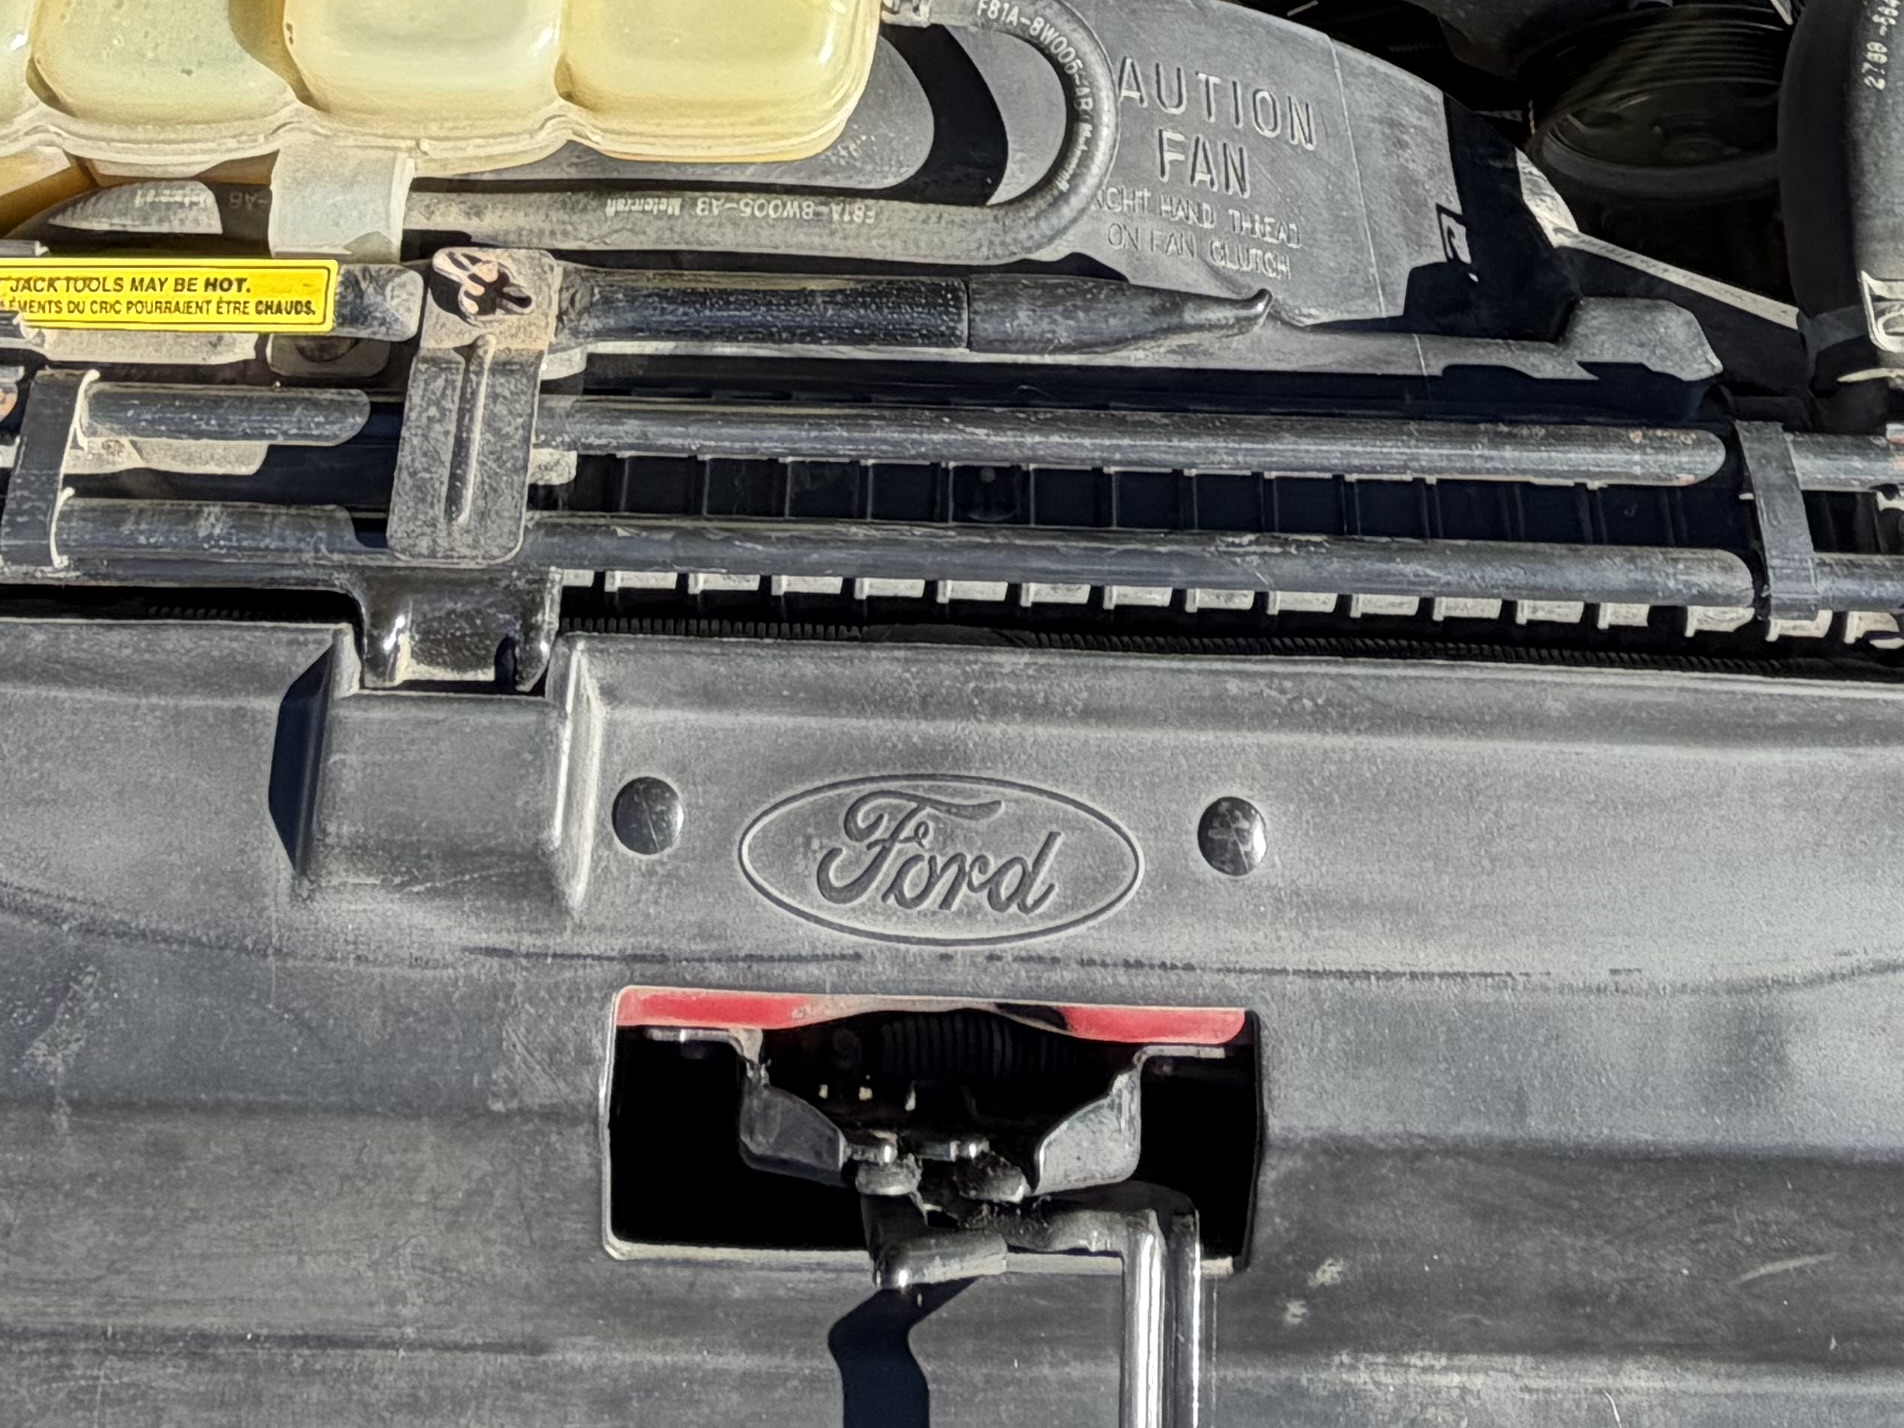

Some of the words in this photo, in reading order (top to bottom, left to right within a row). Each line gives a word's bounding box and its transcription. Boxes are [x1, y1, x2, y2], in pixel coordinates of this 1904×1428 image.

[1118, 55, 1317, 150] AUTION
[1157, 127, 1251, 199] FAN
[604, 197, 684, 217] Motorcraft
[695, 196, 878, 222] F81A-8W005-AB
[1159, 195, 1216, 230] HAND
[1228, 207, 1303, 249] THREAD
[1106, 222, 1140, 251] ON
[1151, 229, 1195, 259] FAN
[1209, 238, 1292, 280] CLUTCH
[9, 277, 58, 293] JACK
[64, 277, 124, 293] TOOLS
[129, 277, 169, 293] MAY
[173, 277, 199, 293] BE
[203, 277, 252, 293] HOT.
[67, 300, 86, 315] DU
[89, 299, 122, 315] CRIC
[126, 299, 212, 316] POURRAIENT
[254, 299, 316, 316] CHAUDS.
[816, 789, 1064, 917] Ford
